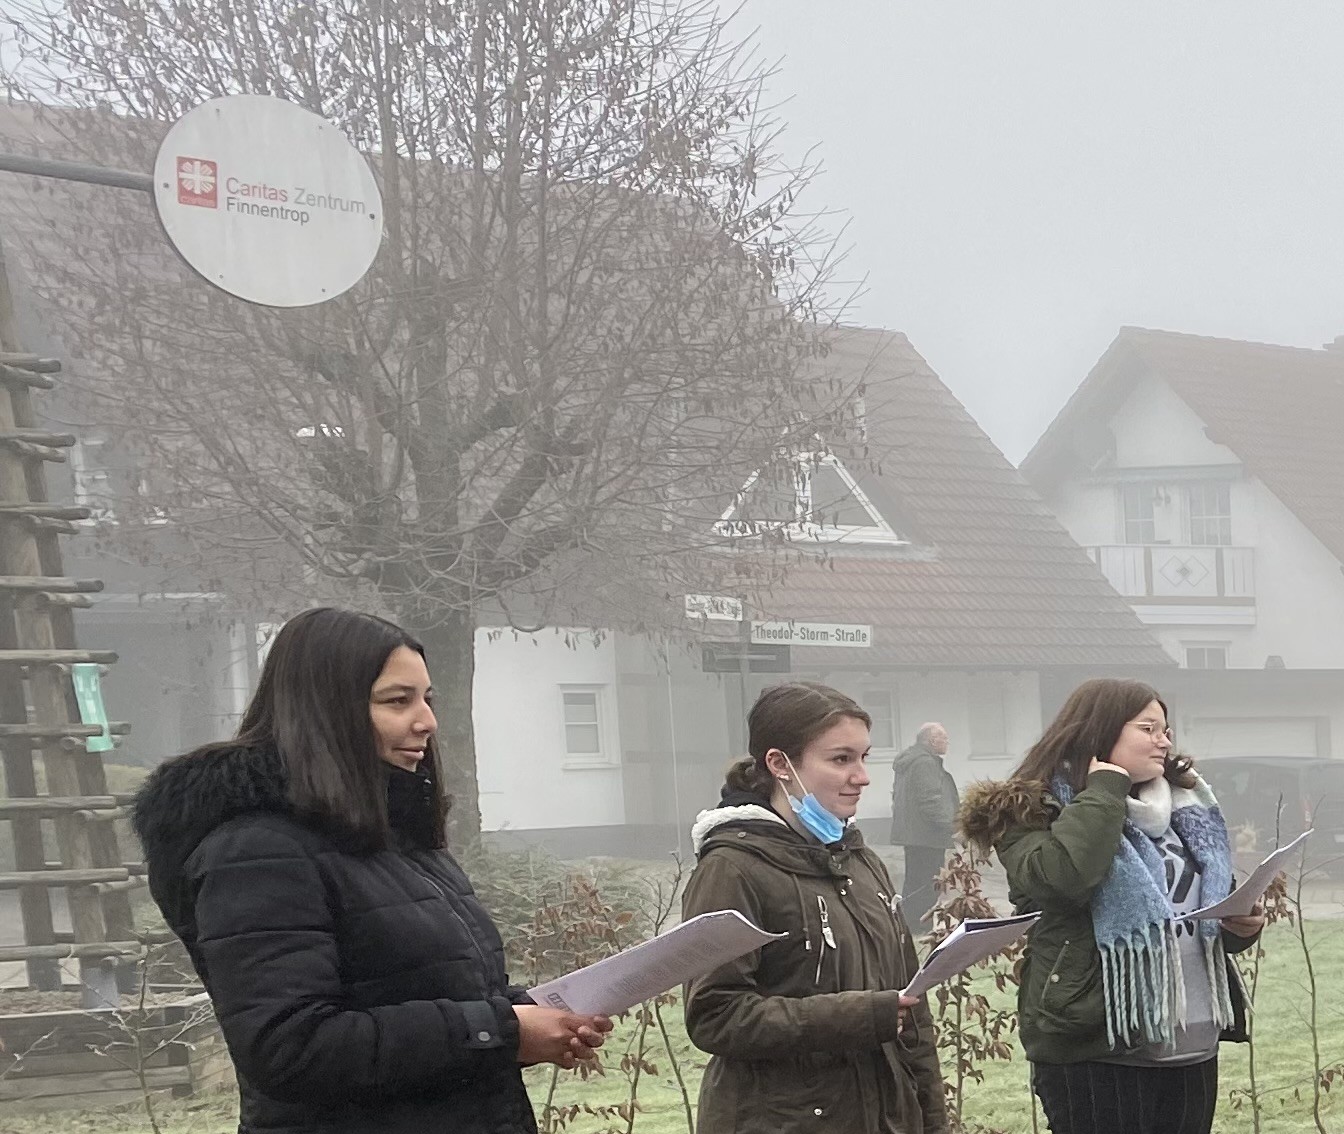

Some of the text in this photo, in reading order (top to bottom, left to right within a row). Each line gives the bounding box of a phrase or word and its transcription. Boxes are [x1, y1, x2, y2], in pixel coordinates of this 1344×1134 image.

[226, 177, 366, 215] Caritas Zentrum
[226, 197, 310, 226] Finnentrop
[754, 625, 868, 643] Theodor-Storm-Straße
